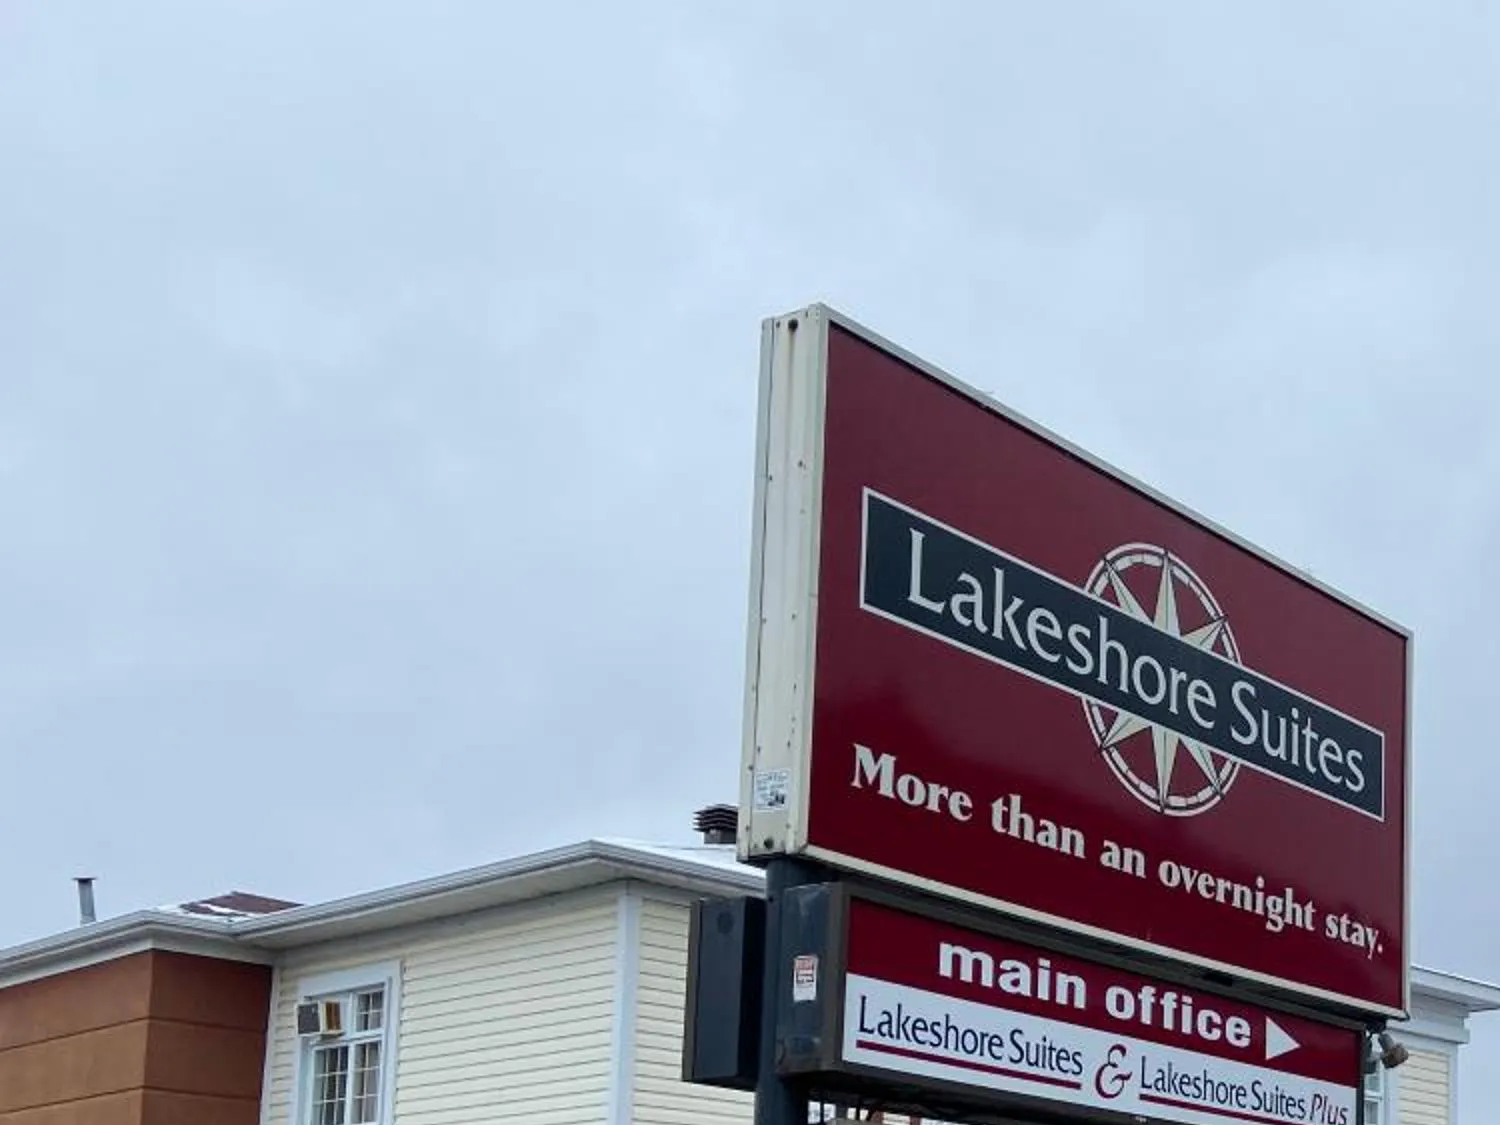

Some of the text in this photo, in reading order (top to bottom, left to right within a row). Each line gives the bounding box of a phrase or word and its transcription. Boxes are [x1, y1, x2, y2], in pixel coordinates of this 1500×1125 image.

[906, 527, 1365, 793] Lakeshore Suites
[852, 742, 973, 822] More
[991, 793, 1086, 859] than
[1099, 838, 1146, 879] an
[1158, 857, 1315, 933] overnight
[1325, 911, 1383, 956] stay.
[859, 995, 1004, 1060] Lakeshore
[1009, 1029, 1083, 1075] Suites
[1095, 1043, 1133, 1099] &
[1140, 1056, 1247, 1108] Lakeshore
[1251, 1080, 1306, 1121] Suites
[938, 941, 1252, 1049] main office
